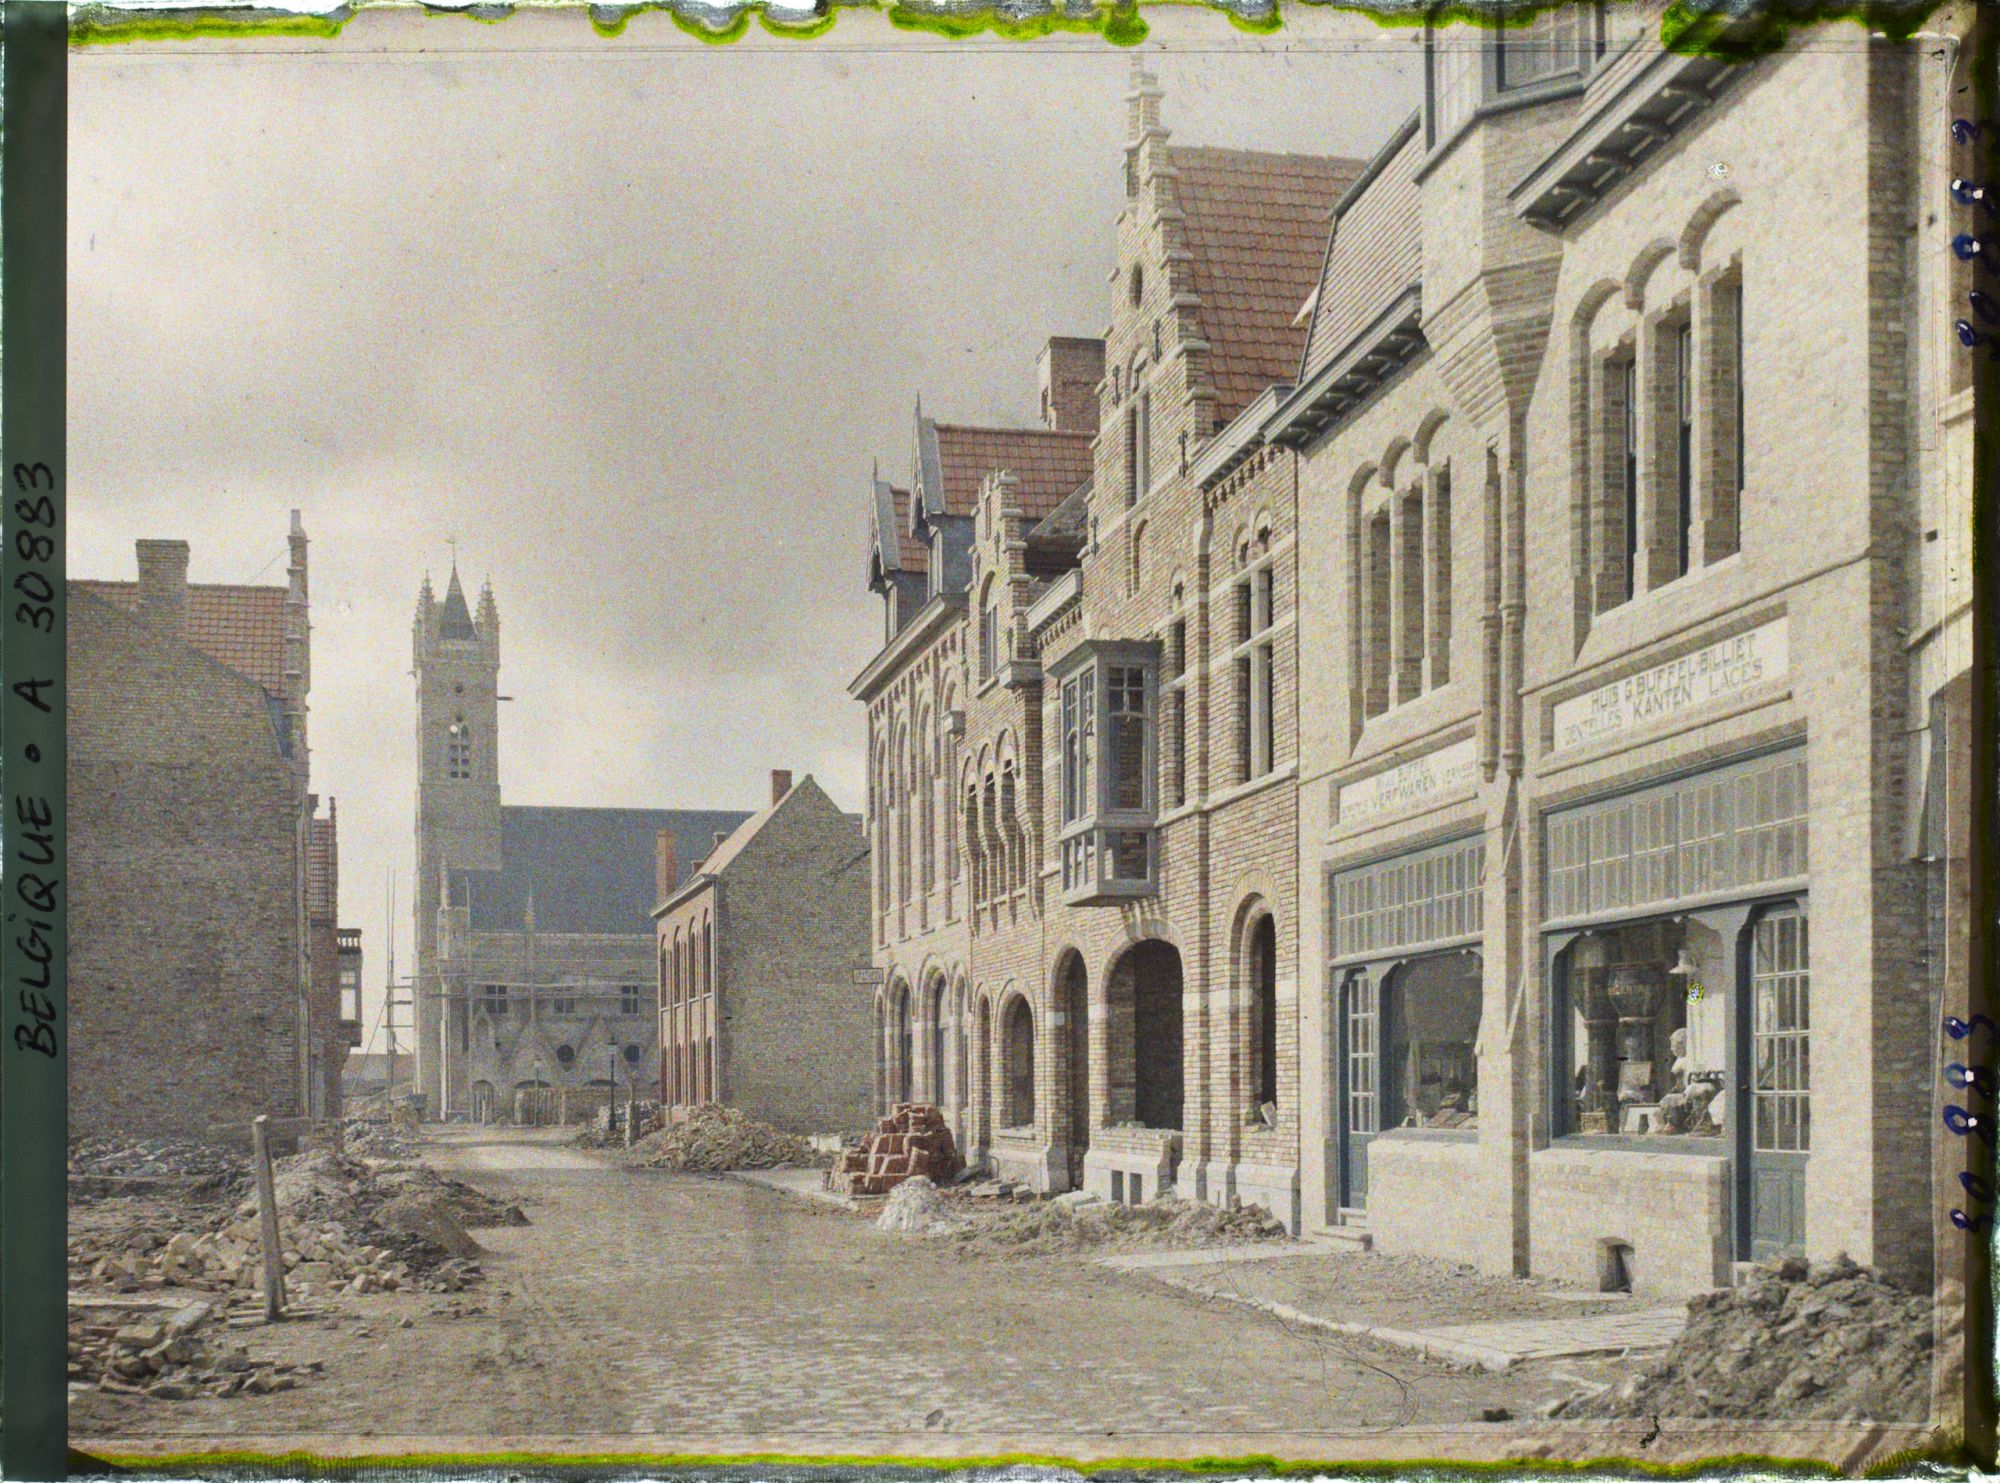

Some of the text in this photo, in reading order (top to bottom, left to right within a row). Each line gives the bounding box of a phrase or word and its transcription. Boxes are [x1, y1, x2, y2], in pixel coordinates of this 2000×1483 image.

[13, 460, 57, 634] 30883
[13, 676, 54, 713] A
[1592, 684, 1619, 713] HUIS
[1633, 685, 1692, 718] KANTEN
[1709, 657, 1763, 695] LACES
